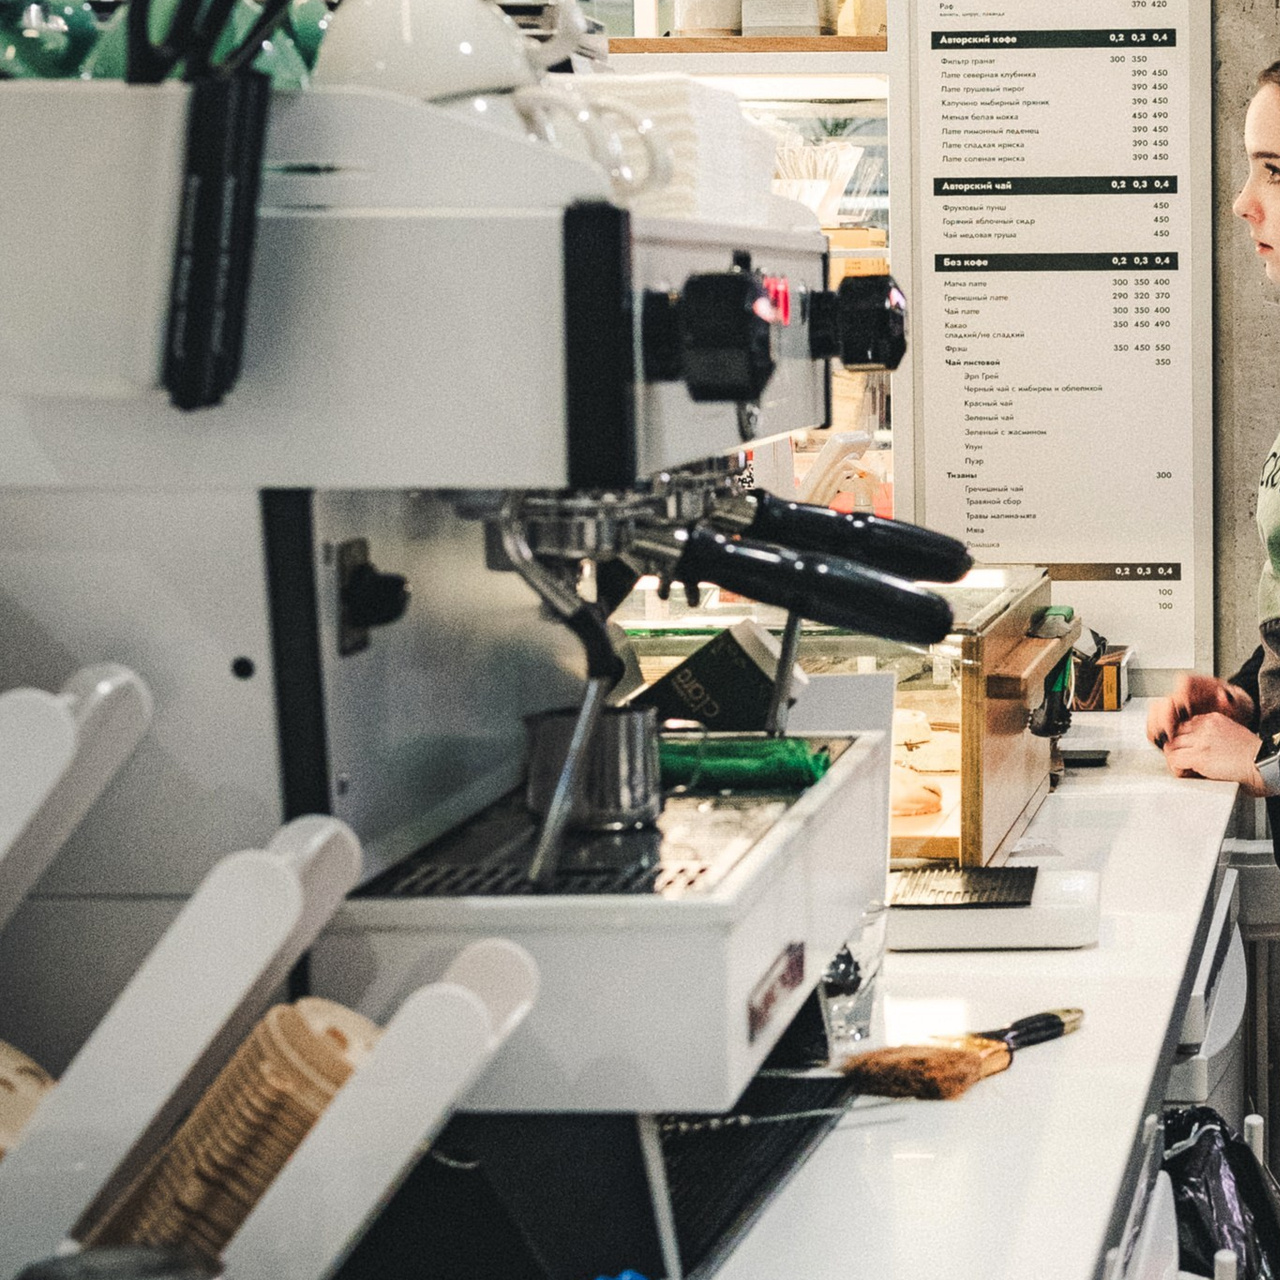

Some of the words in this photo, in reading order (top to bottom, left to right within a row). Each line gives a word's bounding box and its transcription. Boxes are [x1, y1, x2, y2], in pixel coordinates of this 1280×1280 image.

[939, 2, 953, 11] Раф
[1131, 0, 1147, 8] 370
[1151, 0, 1167, 8] 420
[939, 34, 990, 46] Авторский
[992, 34, 1017, 45] кофе
[1109, 34, 1124, 42] 0,2
[1131, 33, 1146, 42] 0,3
[1152, 33, 1168, 42] 0,4
[940, 57, 969, 66] Фильтр
[1132, 69, 1148, 77] 390
[963, 85, 1000, 94] грушевый
[1002, 86, 1024, 94] пирог
[941, 99, 978, 108] Капучино
[1153, 139, 1169, 147] 450
[942, 180, 992, 192] Авторский
[994, 180, 1012, 190] чай
[1111, 180, 1126, 189] 0,2
[1132, 180, 1148, 189] 0,3
[1154, 180, 1169, 188] 0,4
[942, 203, 983, 213] Фруктовый
[986, 205, 1006, 213] пунш
[942, 217, 973, 227] Горячий
[943, 257, 961, 266] Без
[963, 256, 988, 268] кофе
[1112, 256, 1127, 265] 0,2
[1134, 256, 1148, 265] 0,3
[1155, 256, 1170, 265] 0,4
[1112, 278, 1128, 286] 300
[1134, 278, 1150, 286] 350
[1154, 278, 1170, 286] 400
[943, 294, 987, 303] Гречишный
[1112, 292, 1129, 300] 290
[1134, 292, 1150, 300] 320
[944, 307, 959, 315] Чай
[1154, 306, 1170, 314] 400
[944, 321, 967, 329] Какао
[1113, 320, 1129, 328] 350
[1134, 320, 1150, 328] 450
[1154, 320, 1171, 328] 490
[944, 331, 990, 340] сладкий/не
[992, 331, 1024, 340] сладкий
[944, 344, 967, 354] Фрэш
[1113, 344, 1129, 352] 350
[944, 358, 961, 366] Чай
[1155, 358, 1171, 366] 350
[981, 372, 999, 381] Грей
[963, 399, 997, 408] Красный
[964, 442, 982, 452] Улун
[964, 457, 984, 466] Пуэр
[965, 485, 1008, 494] Гречишный
[966, 497, 1001, 506] Травяной
[1002, 497, 1021, 506] сбор
[1115, 567, 1130, 576] 0,2
[1136, 567, 1151, 576] 0,3
[1157, 567, 1173, 575] 0,4
[1158, 588, 1173, 596] 100
[1158, 602, 1173, 610] 100
